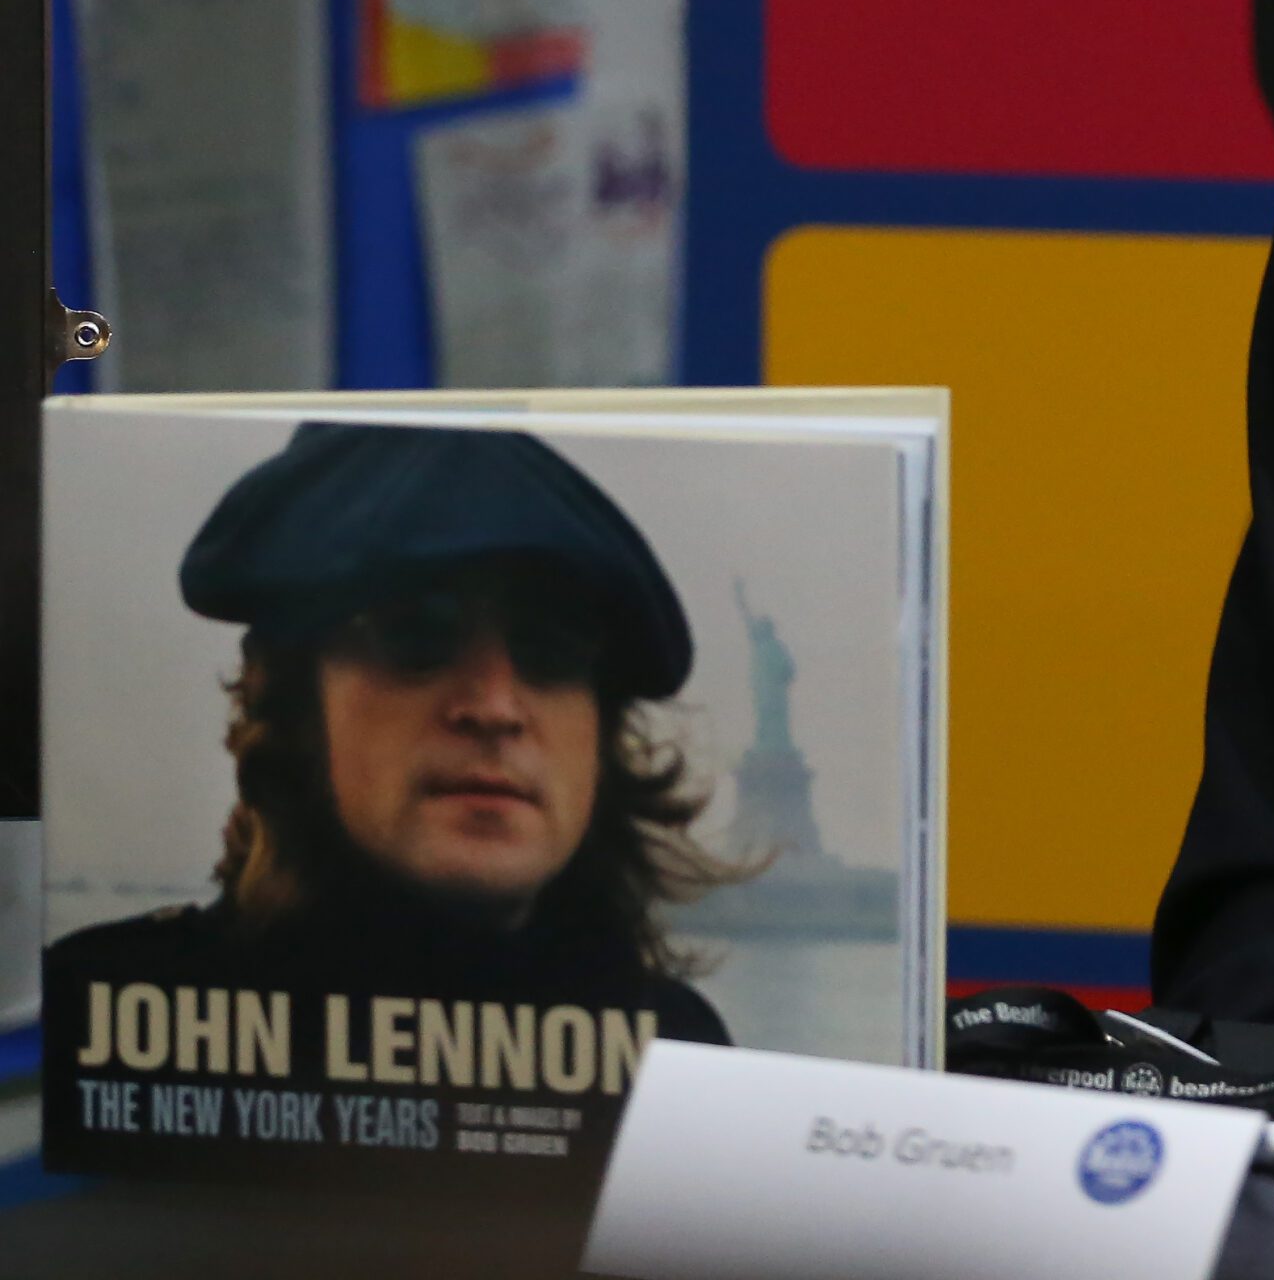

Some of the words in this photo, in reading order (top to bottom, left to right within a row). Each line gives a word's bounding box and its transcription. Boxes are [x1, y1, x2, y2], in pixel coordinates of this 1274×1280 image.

[78, 982, 291, 1077] JOHN
[325, 994, 656, 1096] LENNON
[994, 1001, 1057, 1028] Beatl
[78, 1079, 141, 1132] THE
[151, 1083, 224, 1137] NEW
[232, 1088, 323, 1143] YORK
[334, 1094, 440, 1150] YEARS
[807, 1116, 884, 1159] Bob
